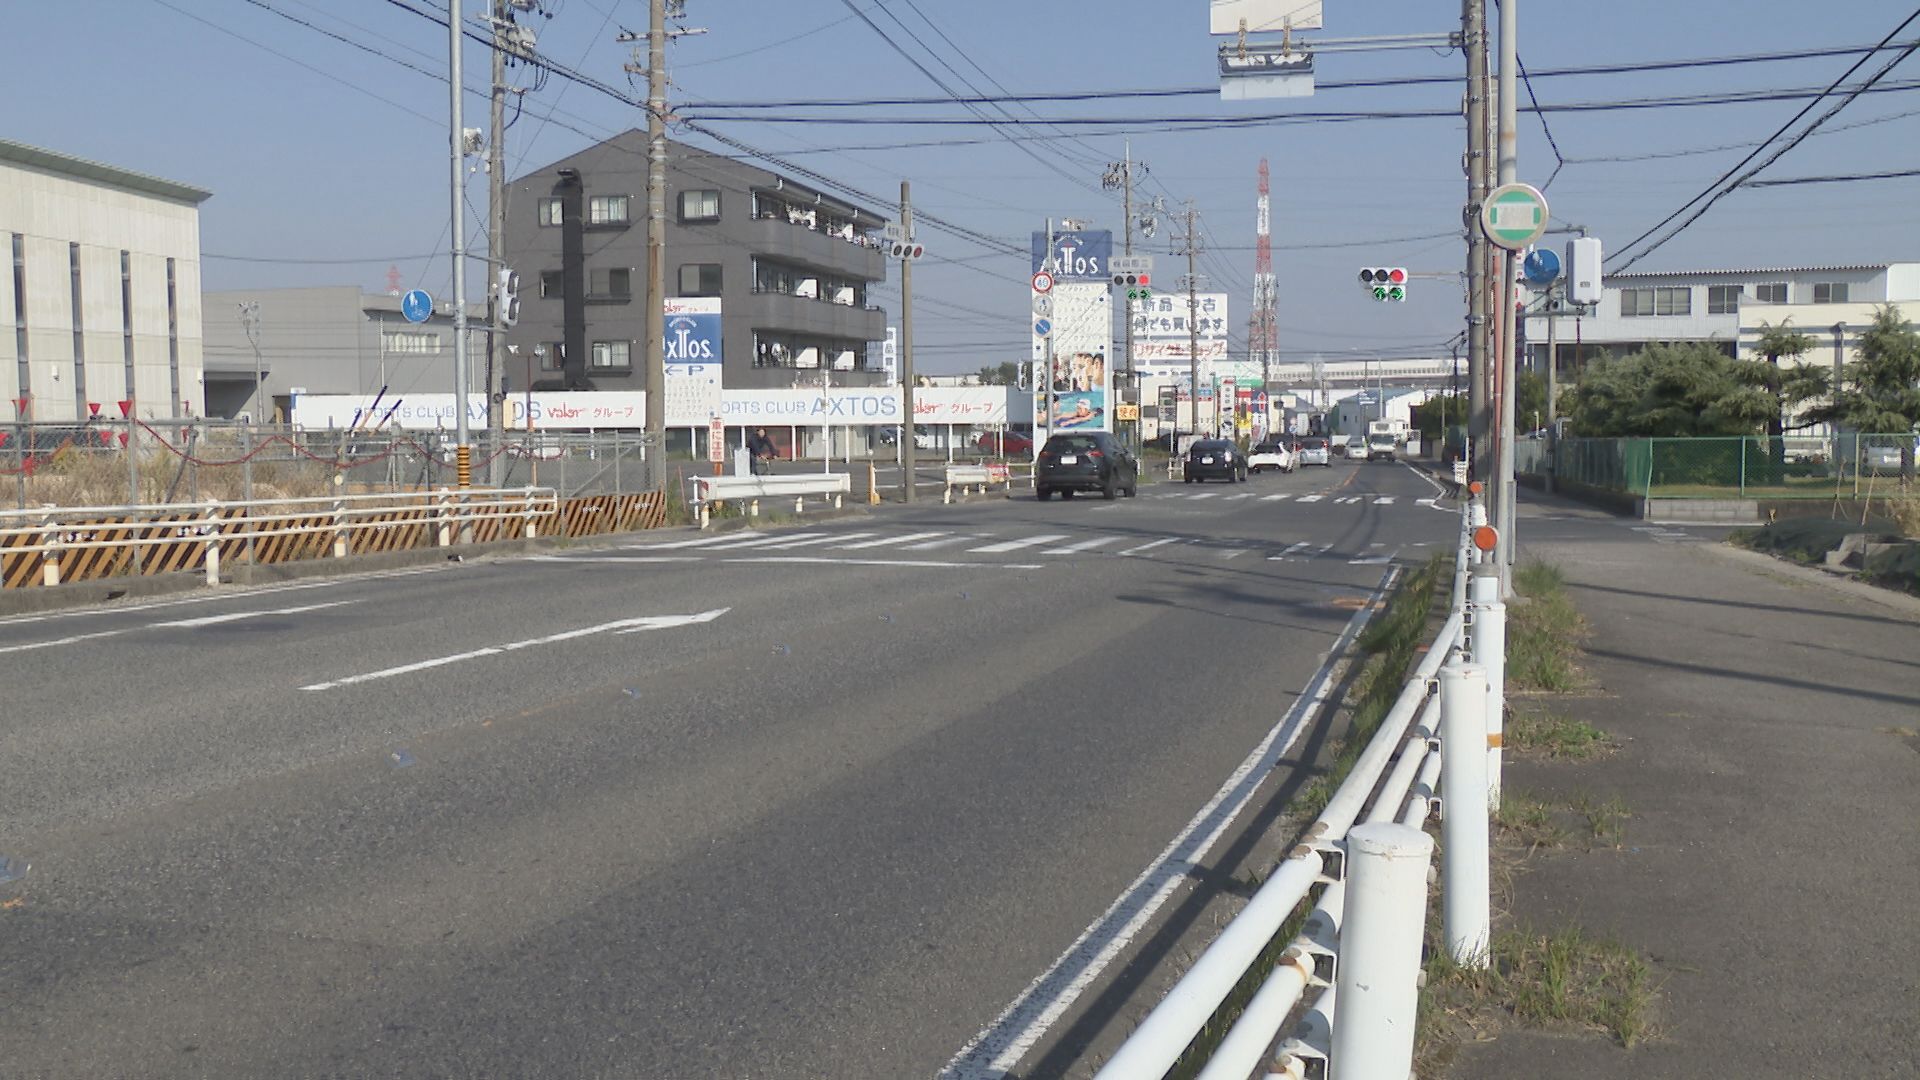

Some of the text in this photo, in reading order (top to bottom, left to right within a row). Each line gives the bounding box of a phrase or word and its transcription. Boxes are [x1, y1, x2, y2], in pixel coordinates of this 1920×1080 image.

[688, 365, 704, 376] P
[765, 401, 806, 414] CLUB
[810, 396, 897, 416] AXTOS
[414, 407, 455, 418] CLUB
